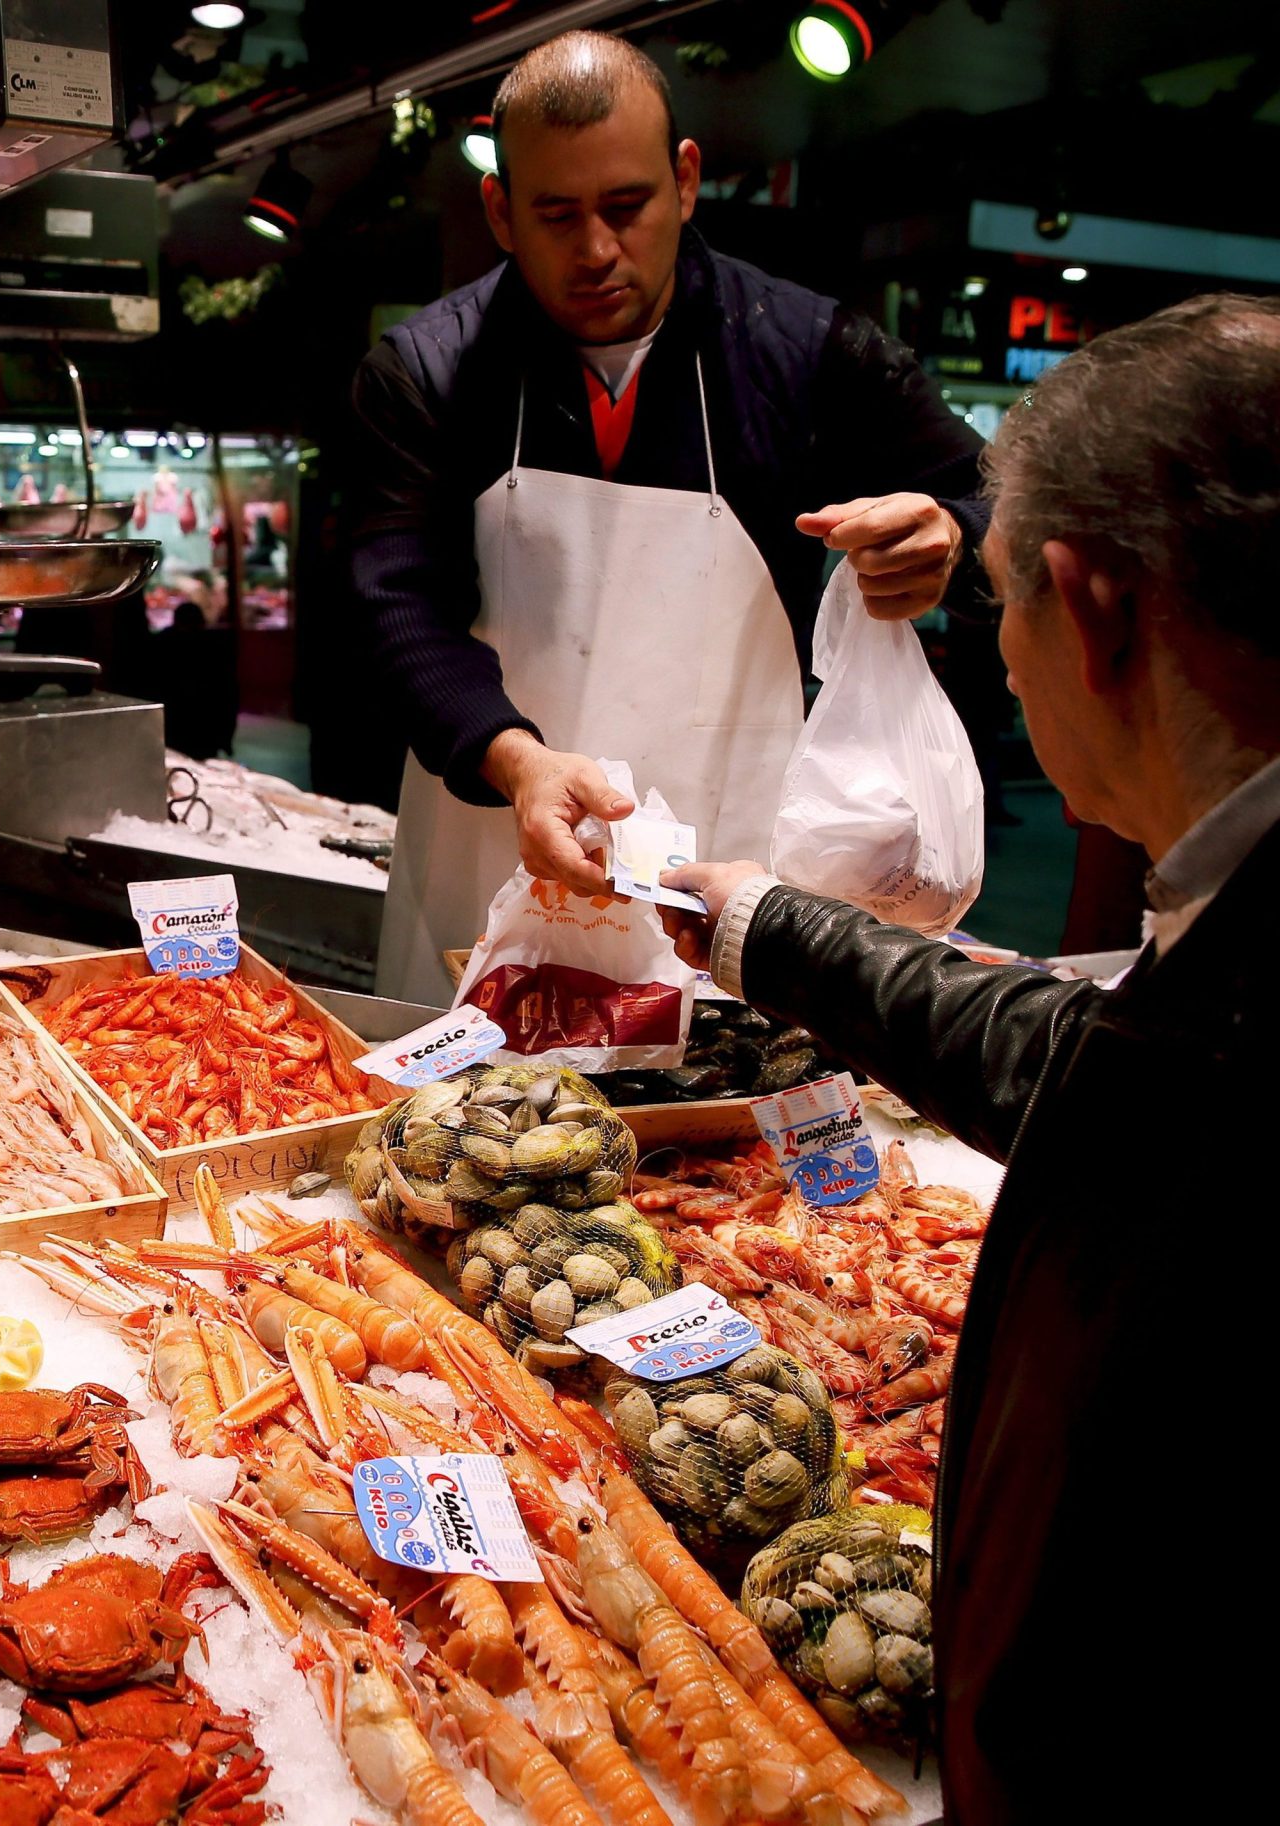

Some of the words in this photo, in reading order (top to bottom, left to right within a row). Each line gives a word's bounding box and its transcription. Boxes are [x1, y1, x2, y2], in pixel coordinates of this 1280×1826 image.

[178, 962, 212, 972] Kilo
[394, 1028, 466, 1067] Precio
[784, 1116, 862, 1156] Langostinos
[823, 1129, 855, 1148] cocidos
[821, 1177, 855, 1195] Kilo
[627, 1315, 707, 1353] Precio
[678, 1348, 727, 1369] Kilo
[369, 1489, 388, 1530] Kilo
[427, 1472, 478, 1556] Cigalas
[433, 1505, 458, 1551] Gordas
